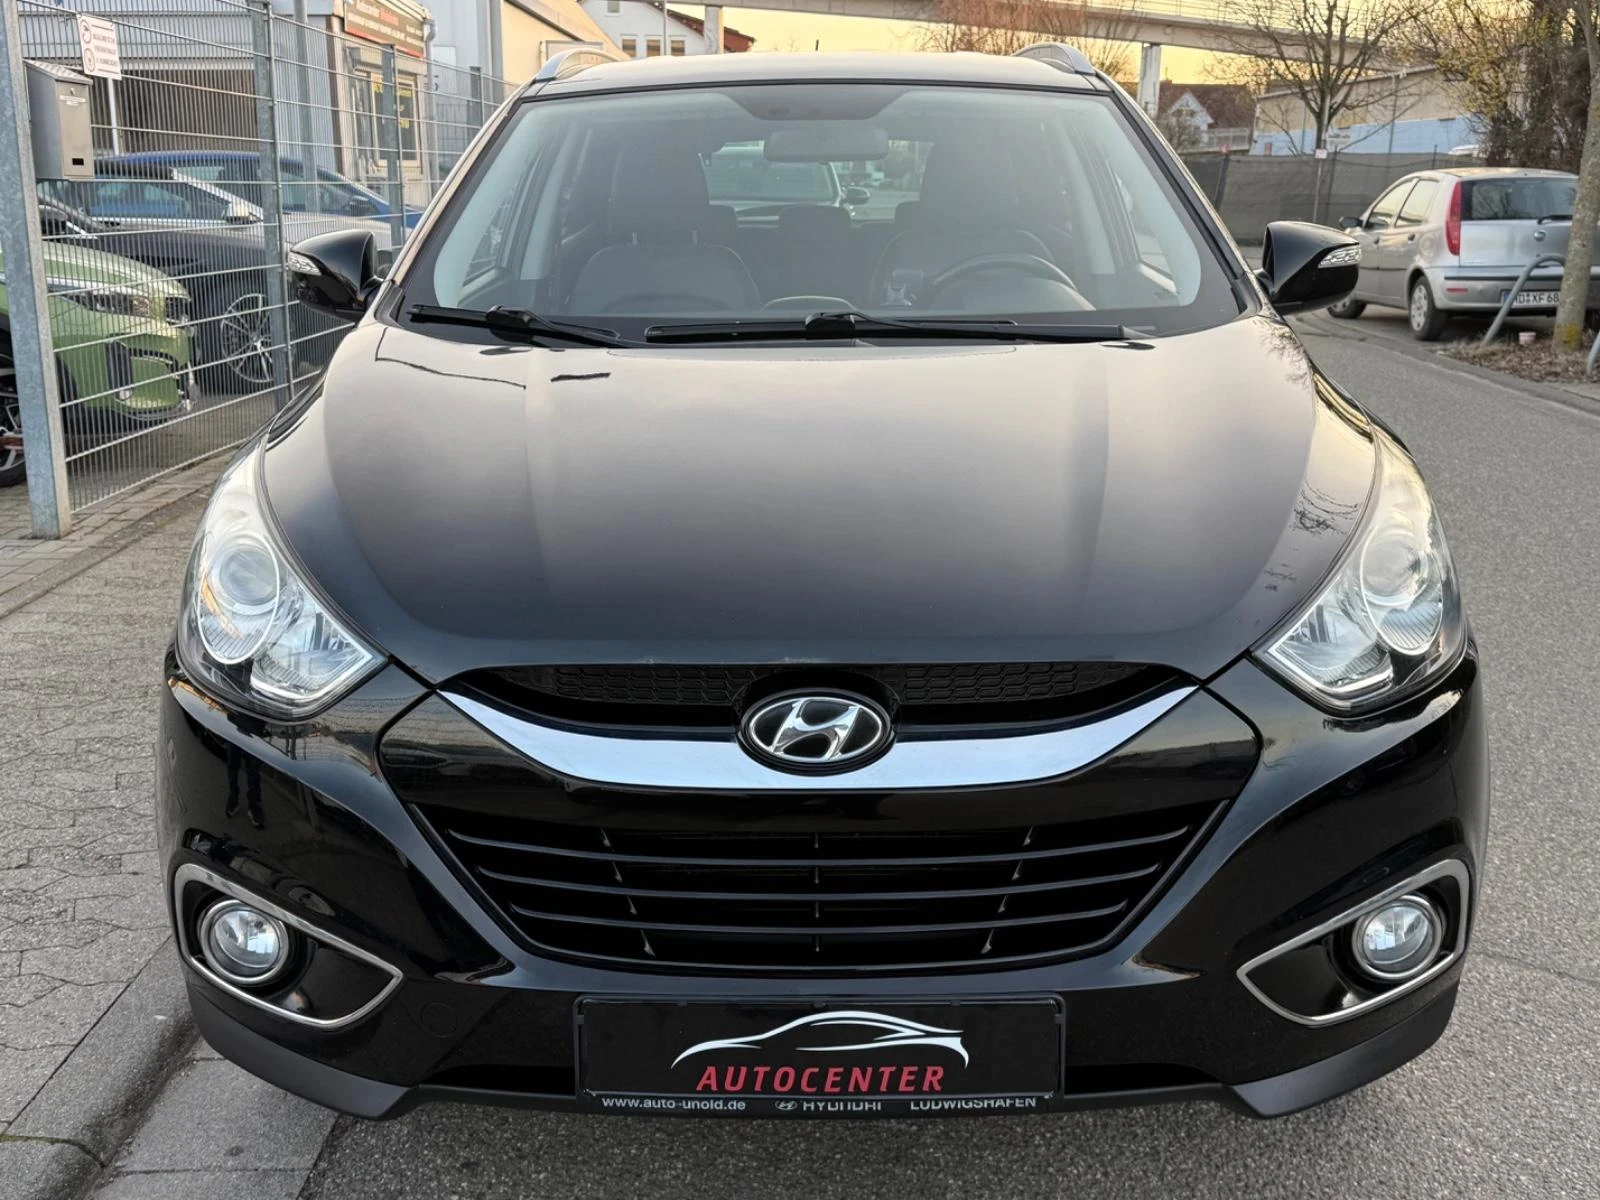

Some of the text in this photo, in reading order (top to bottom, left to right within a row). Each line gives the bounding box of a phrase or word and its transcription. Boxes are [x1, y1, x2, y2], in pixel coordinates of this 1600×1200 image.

[696, 1066, 945, 1093] AUTOCENTER
[601, 1097, 746, 1111] www.auto-unold.de
[910, 1097, 1037, 1111] LUDWIGSHAFEN
